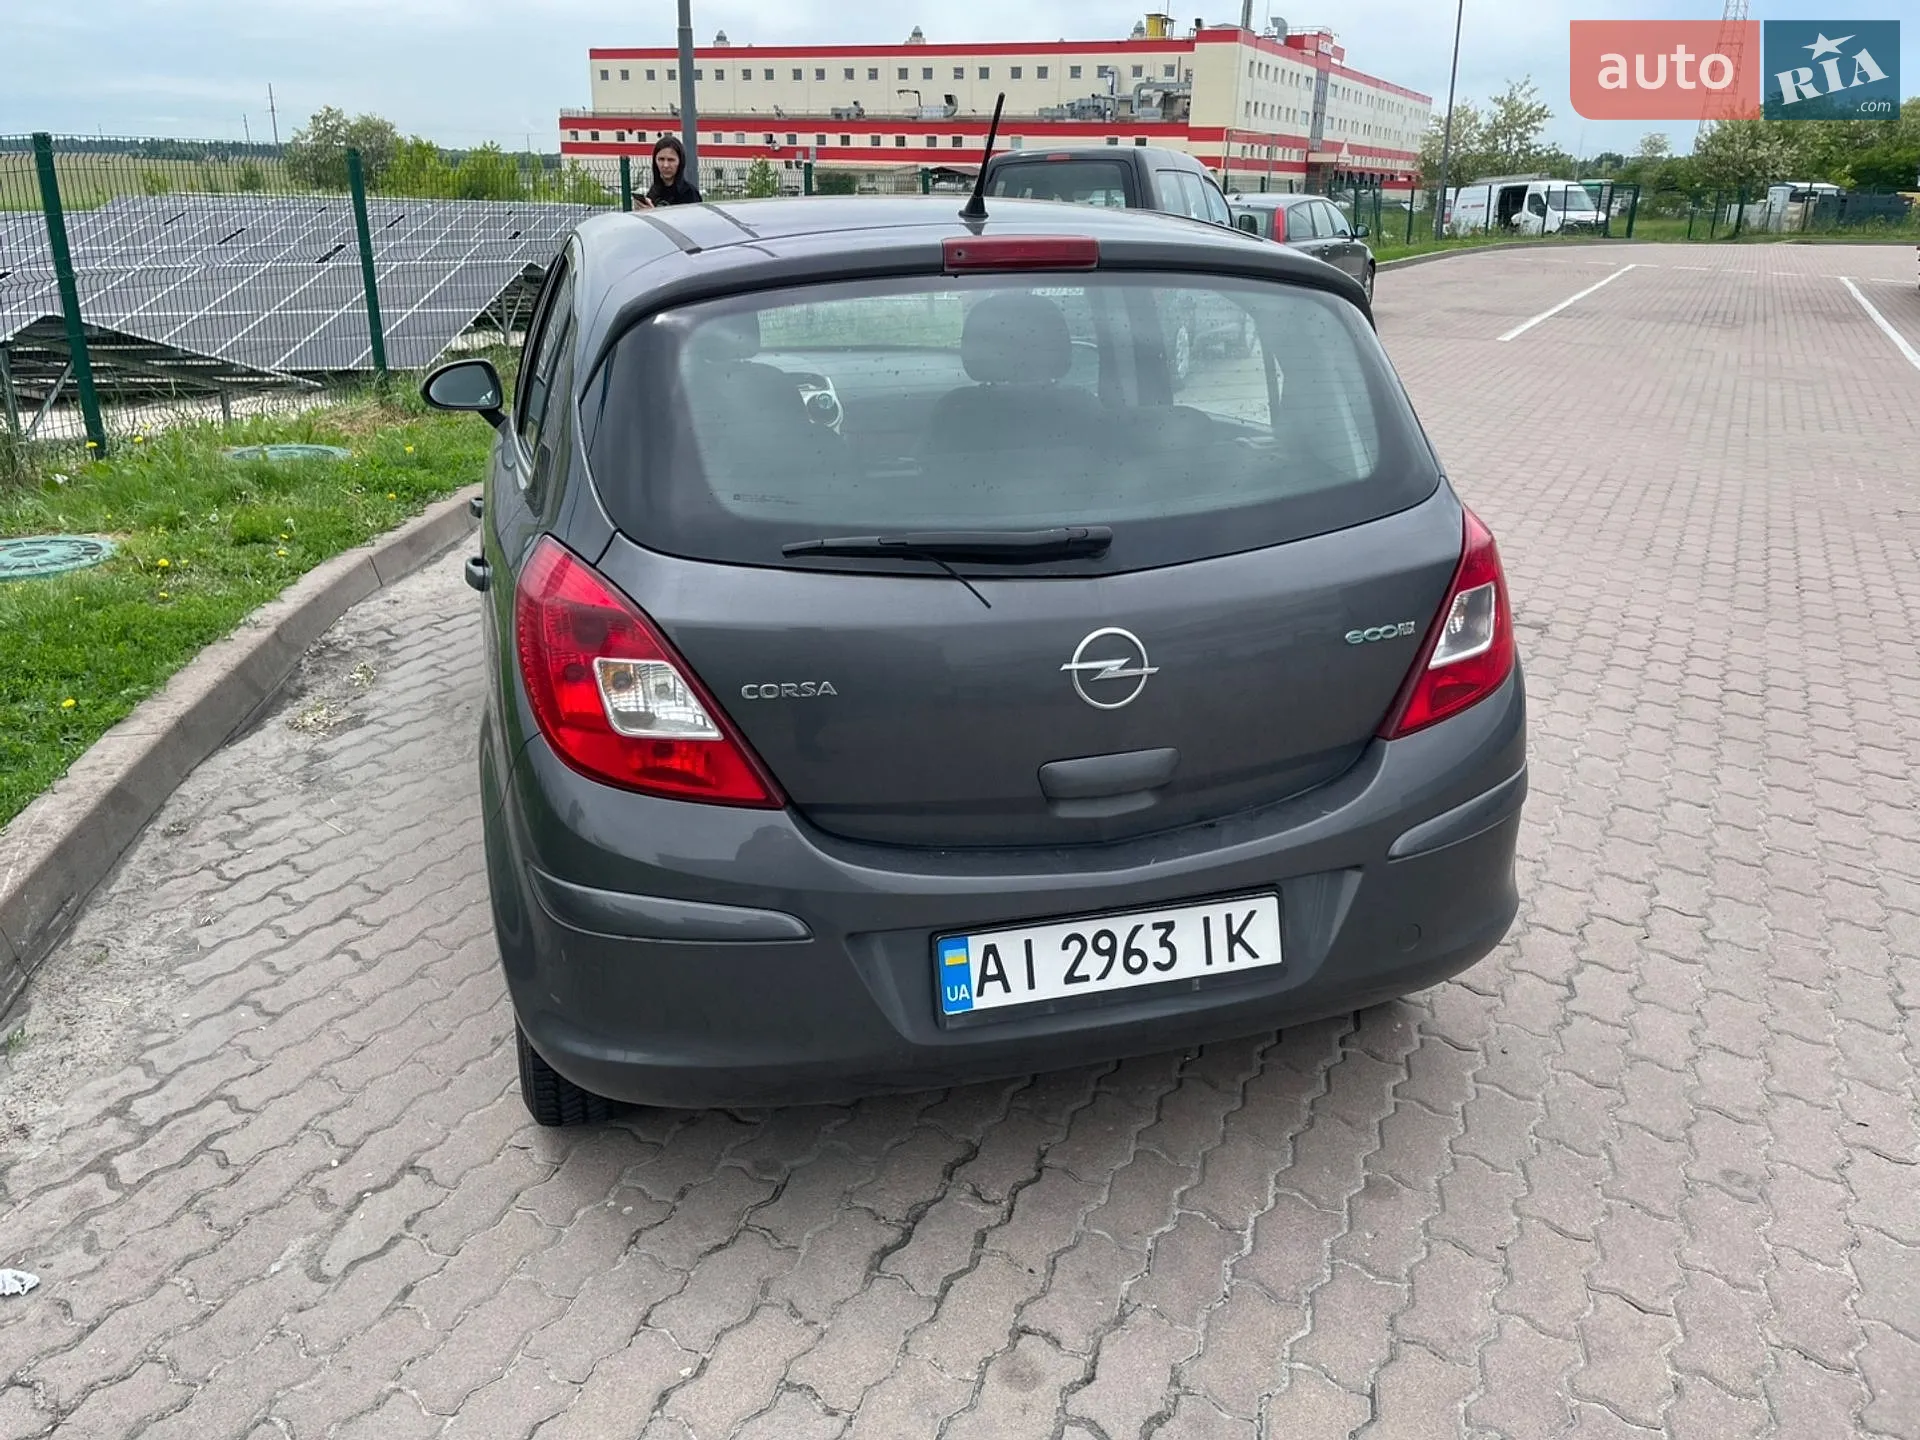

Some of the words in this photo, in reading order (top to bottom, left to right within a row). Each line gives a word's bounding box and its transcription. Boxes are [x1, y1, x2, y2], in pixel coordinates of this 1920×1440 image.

[741, 681, 838, 699] CORSA
[976, 938, 1036, 998] AI
[1061, 920, 1178, 985] 2963
[1202, 909, 1260, 966] IK
[946, 985, 971, 1002] UA
